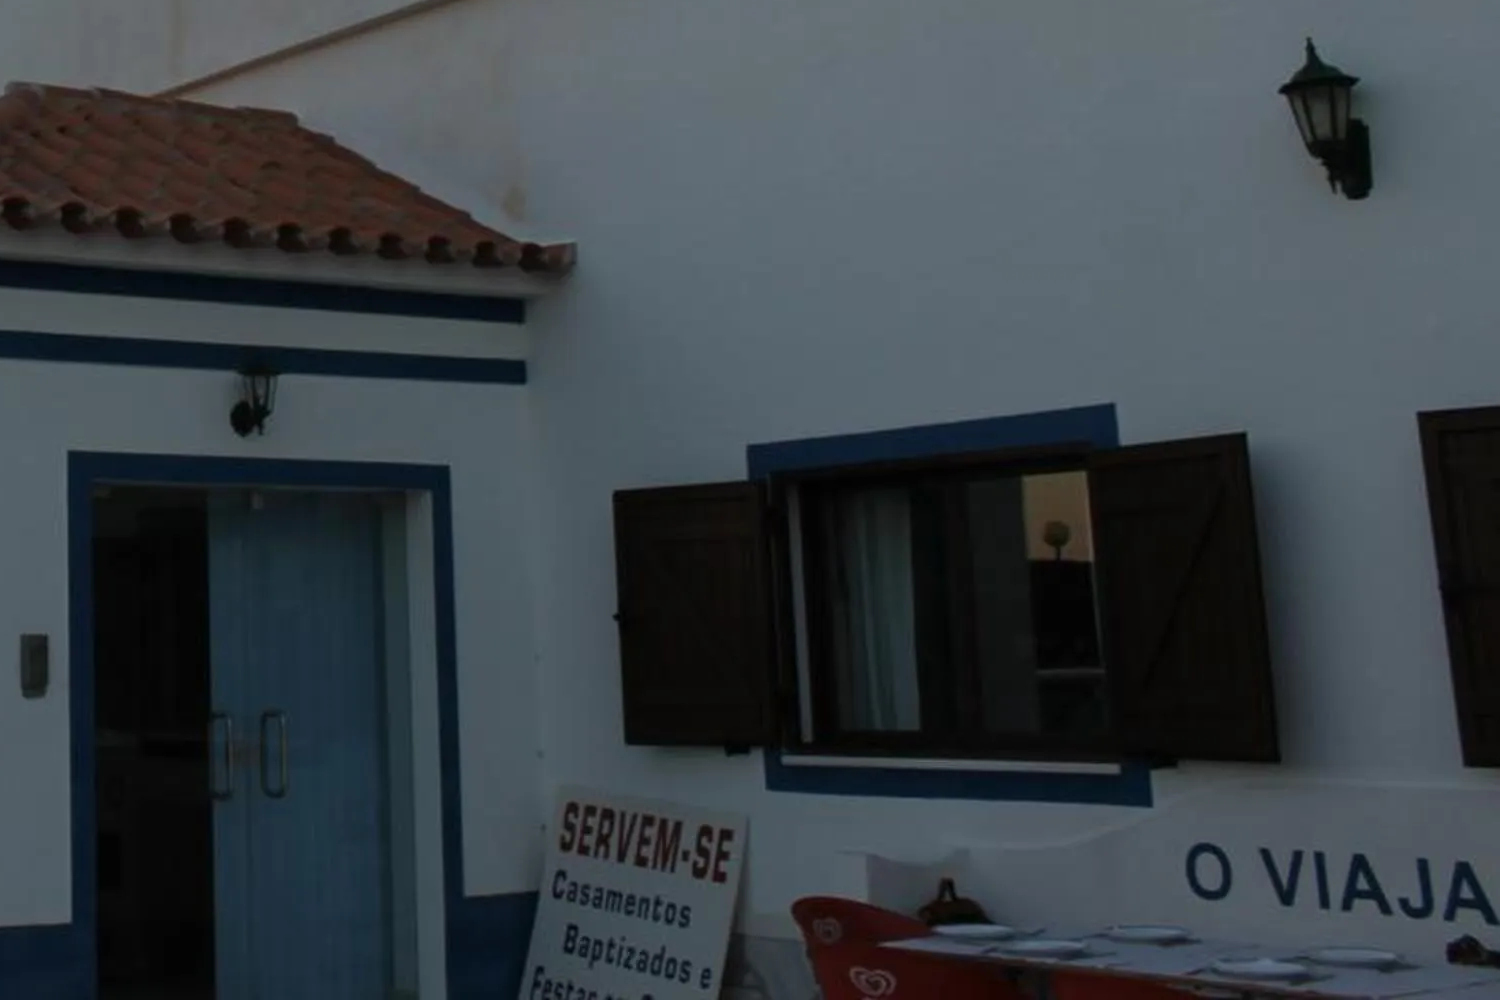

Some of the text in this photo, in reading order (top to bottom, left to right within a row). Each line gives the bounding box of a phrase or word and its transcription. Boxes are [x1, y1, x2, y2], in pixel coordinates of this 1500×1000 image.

[559, 801, 735, 883] SERVEM-SE
[552, 869, 692, 928] Casamentos
[1185, 842, 1500, 925] O VIAJA
[563, 923, 713, 990] Baptizados e
